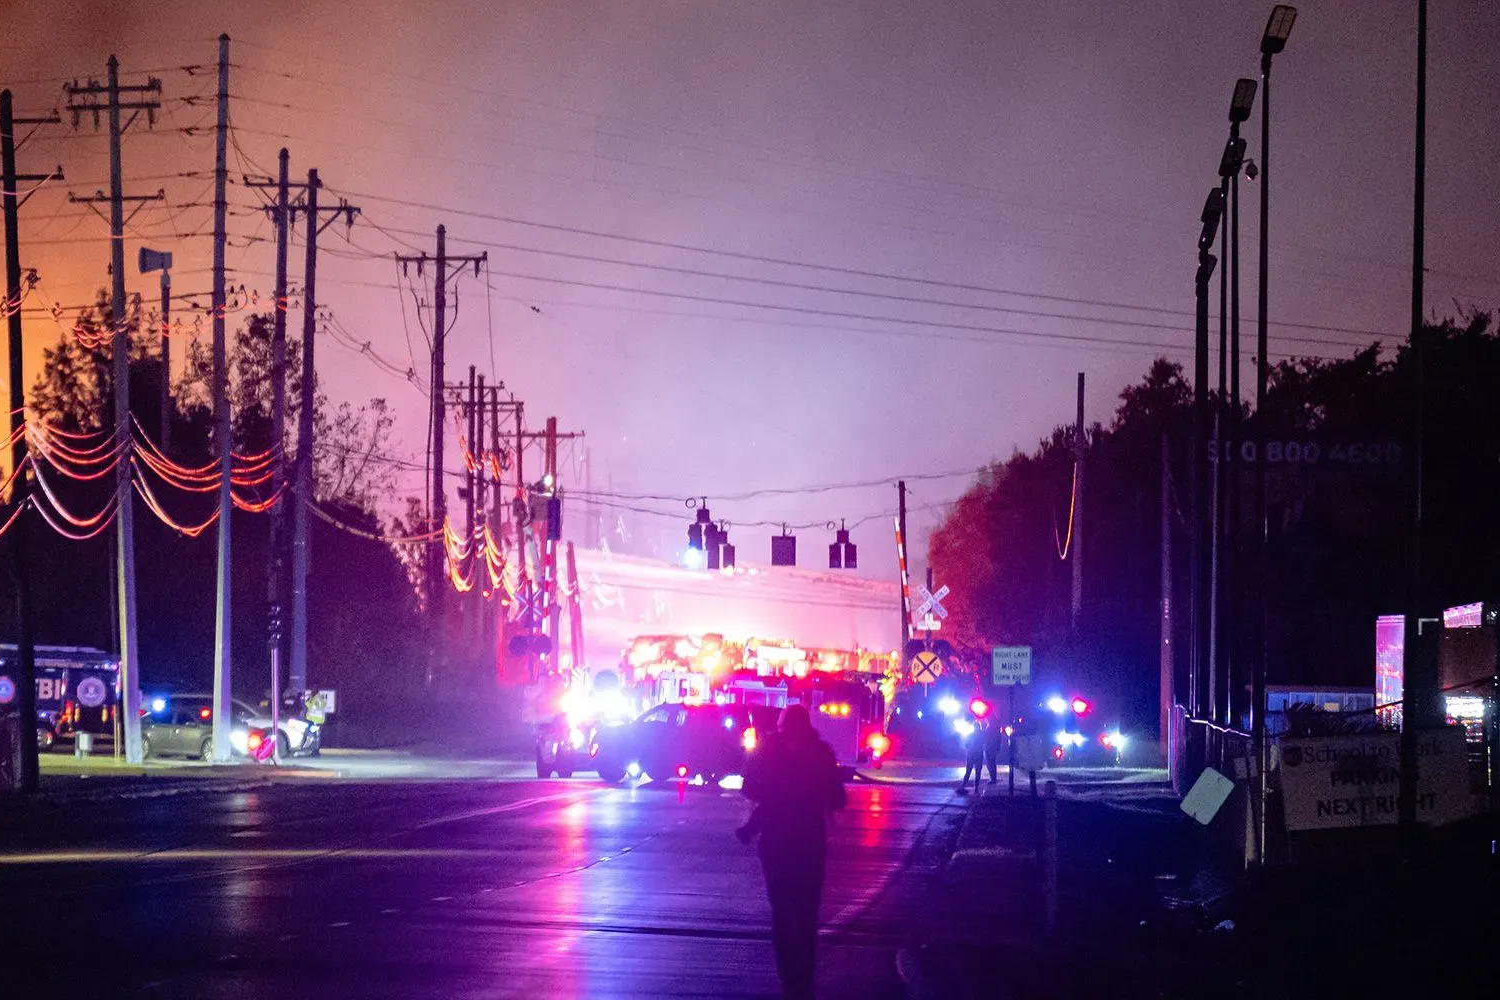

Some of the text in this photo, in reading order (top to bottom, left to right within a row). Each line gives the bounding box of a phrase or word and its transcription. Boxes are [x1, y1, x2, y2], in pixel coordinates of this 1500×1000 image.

[1001, 662, 1022, 670] MUST
[34, 677, 61, 699] BI
[1303, 743, 1367, 765] School
[1330, 767, 1420, 787] PARKIN
[1316, 793, 1437, 816] NEXT RIHT
